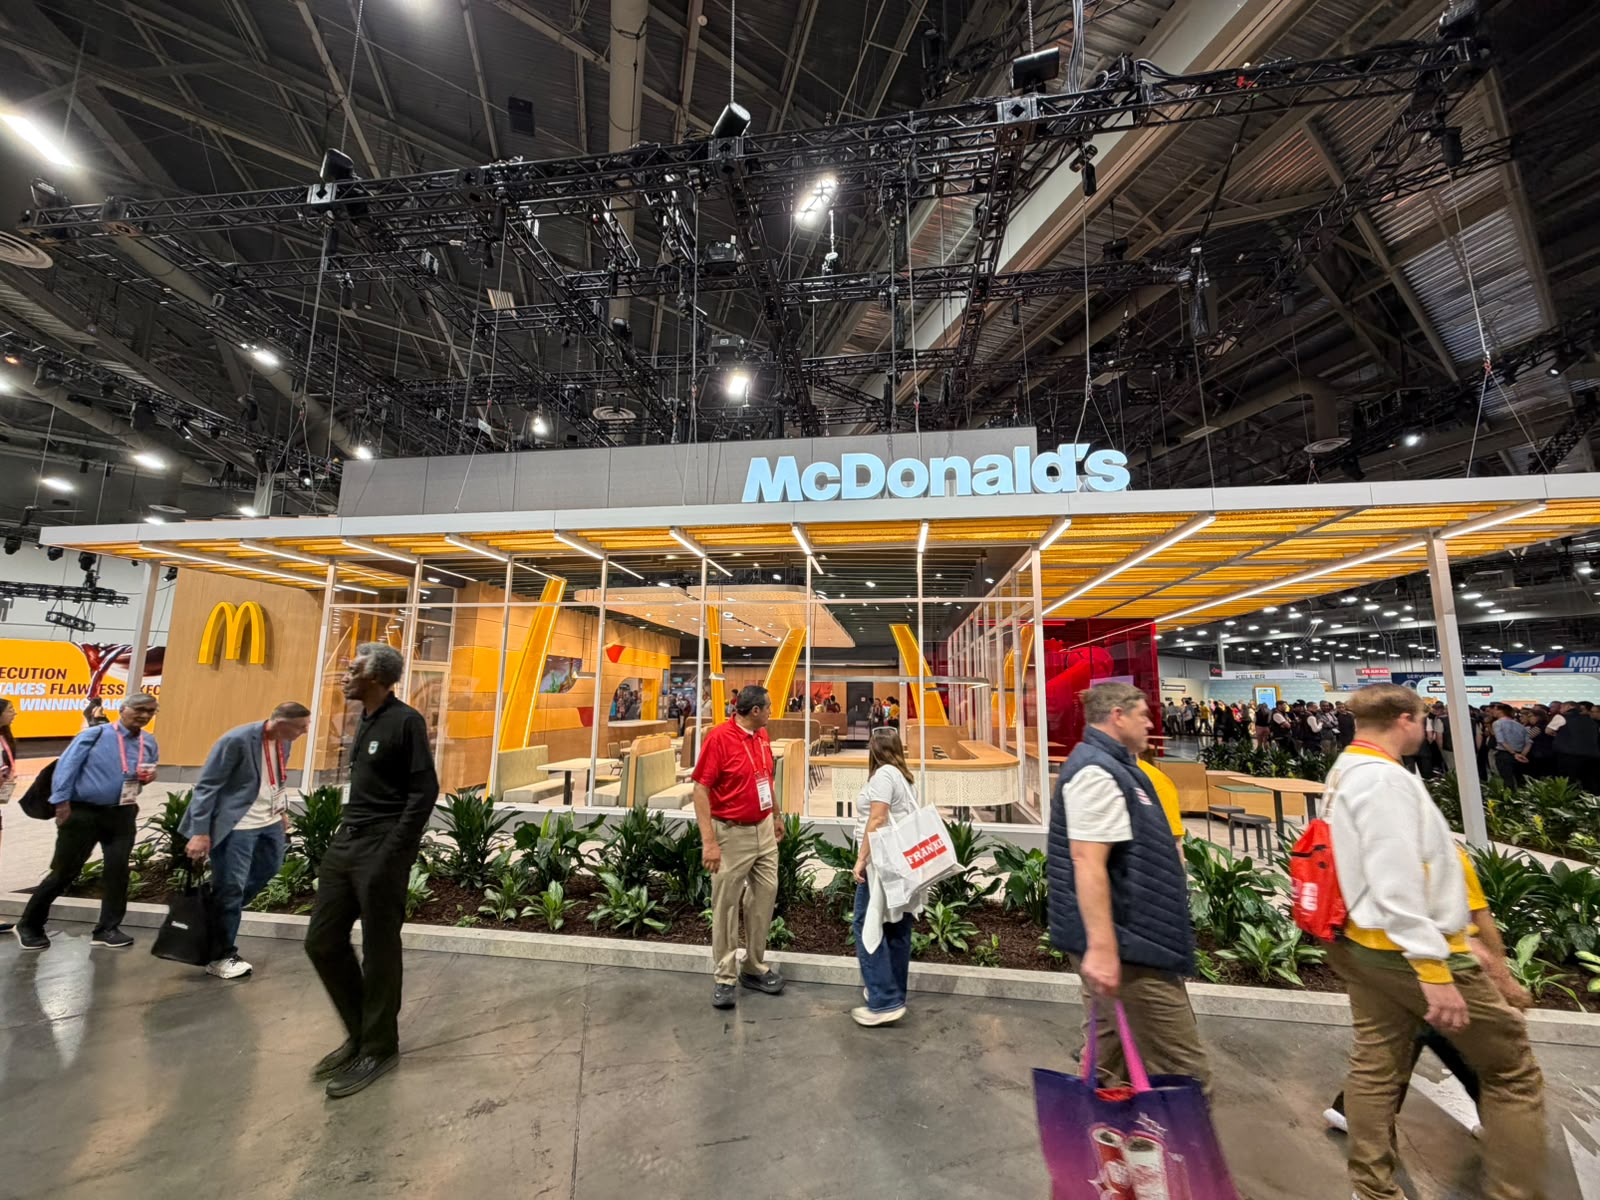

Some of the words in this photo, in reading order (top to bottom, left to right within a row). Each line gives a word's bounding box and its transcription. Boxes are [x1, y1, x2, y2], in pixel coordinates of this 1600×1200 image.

[741, 443, 1131, 503] McDonald's
[1568, 656, 1600, 668] MID
[50, 683, 125, 696] FLAWESS
